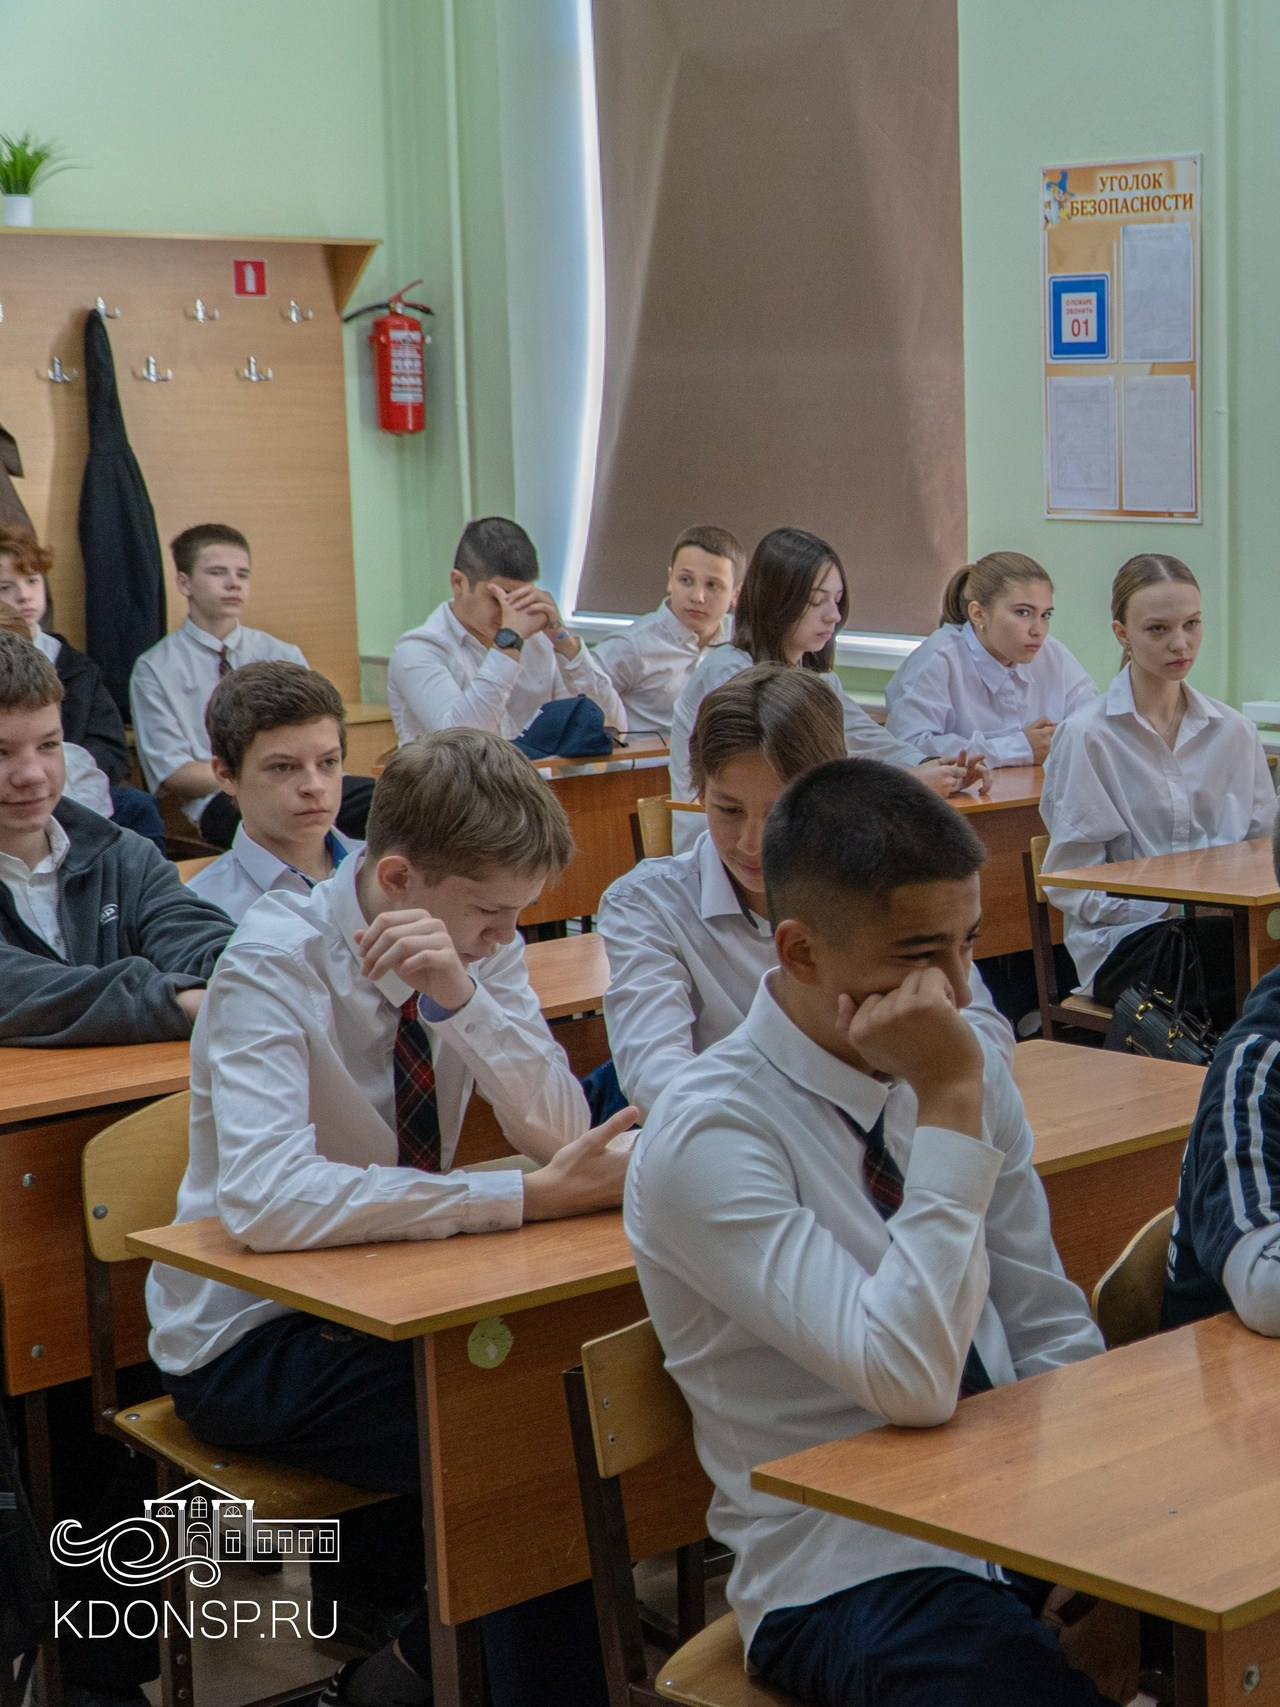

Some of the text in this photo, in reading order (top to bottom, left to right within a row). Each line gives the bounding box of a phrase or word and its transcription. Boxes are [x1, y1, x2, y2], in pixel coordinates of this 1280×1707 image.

[1099, 172, 1163, 193] УГОЛОК
[1070, 192, 1194, 217] БЕЗОПАСНОСТИ
[1071, 318, 1089, 337] 01
